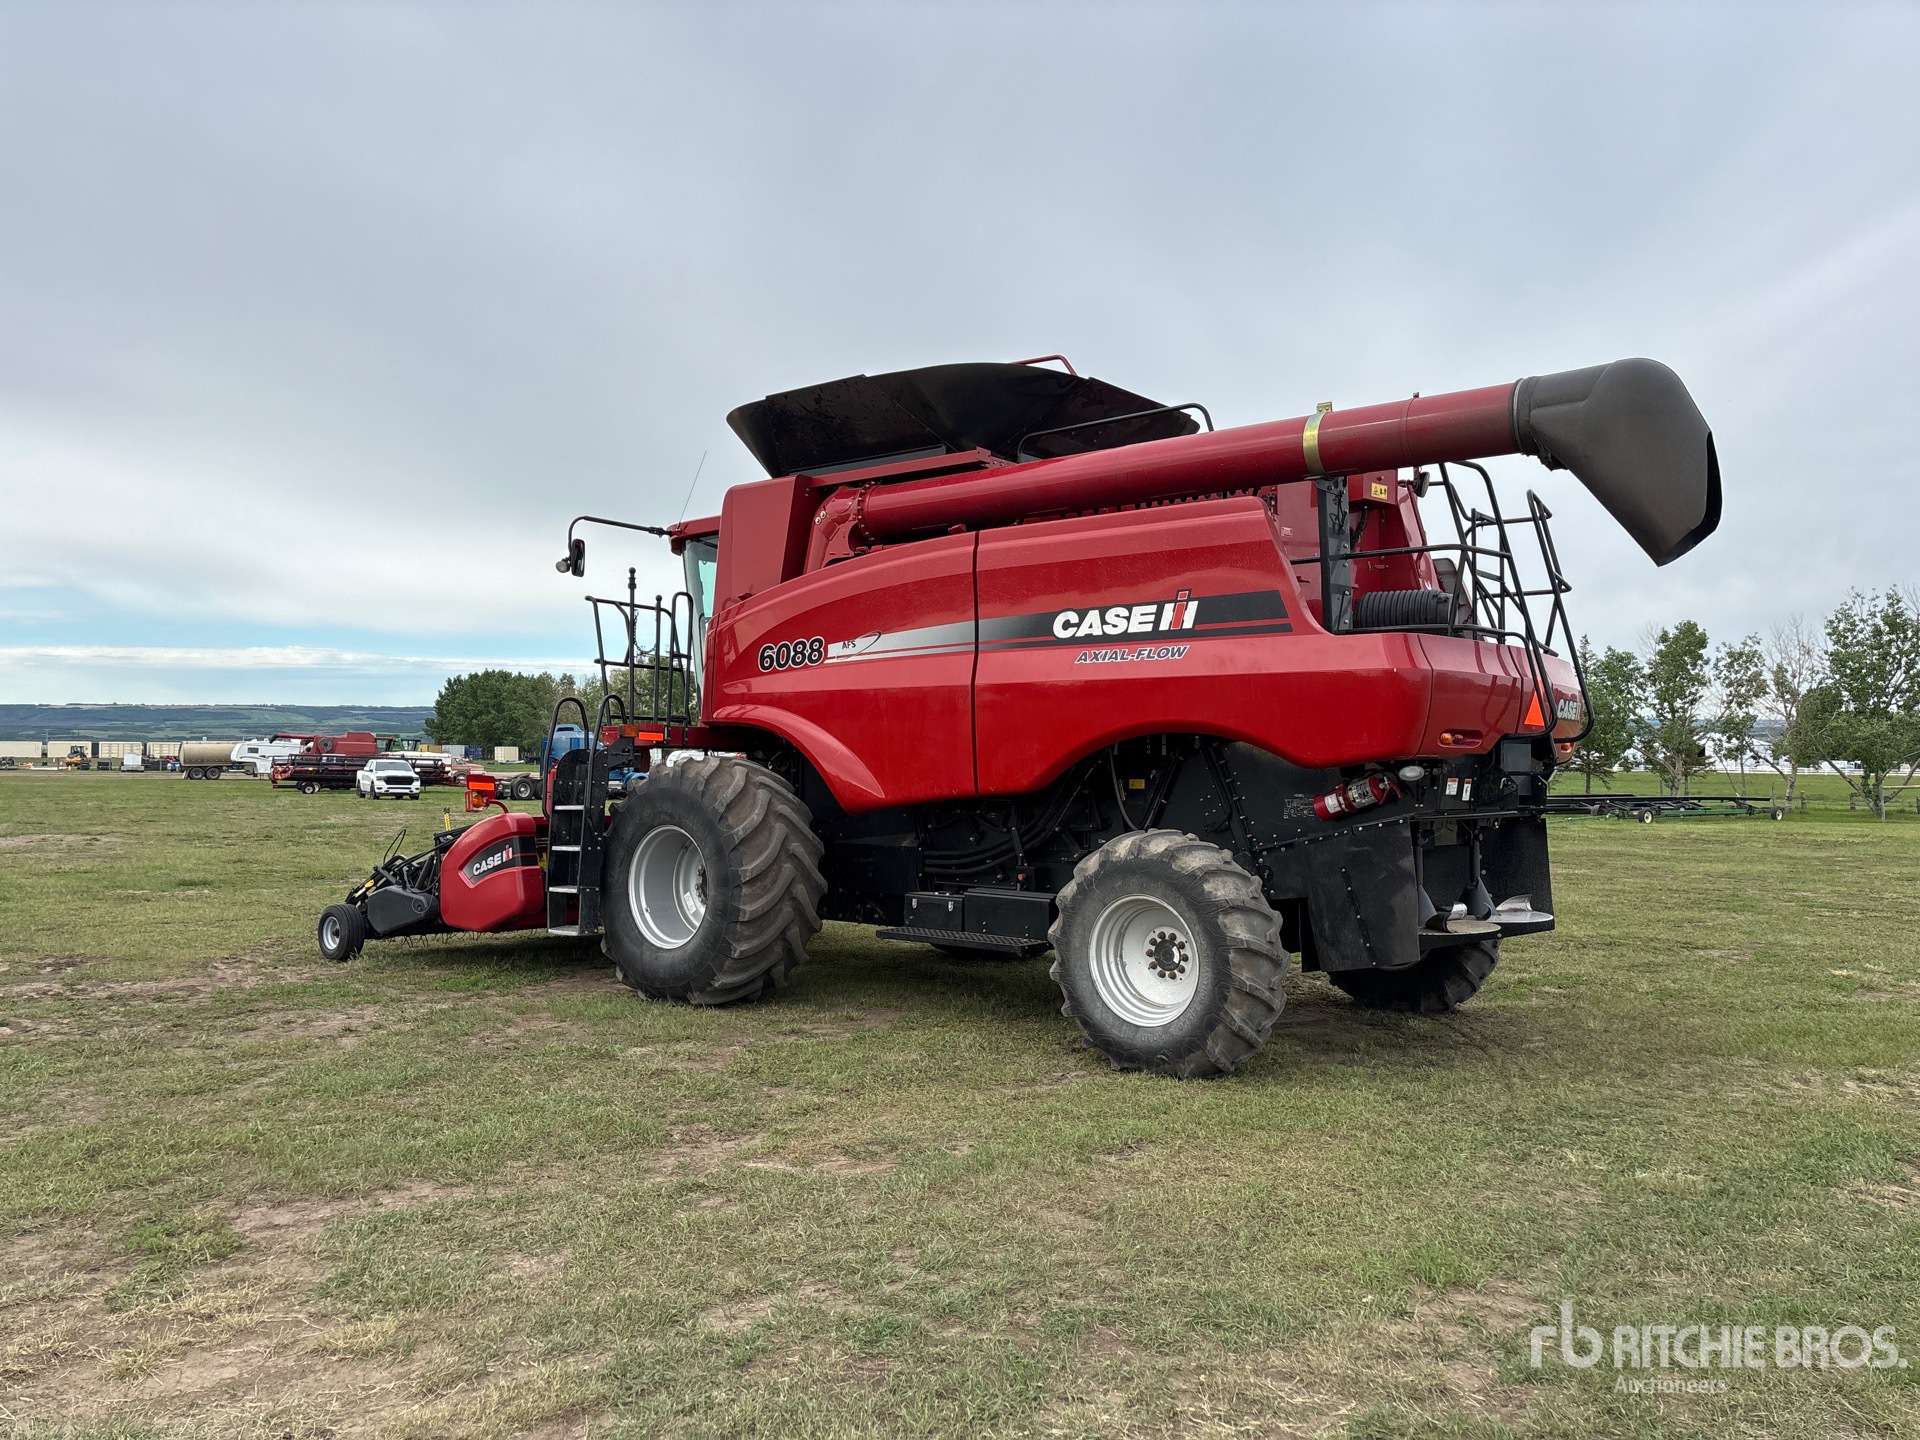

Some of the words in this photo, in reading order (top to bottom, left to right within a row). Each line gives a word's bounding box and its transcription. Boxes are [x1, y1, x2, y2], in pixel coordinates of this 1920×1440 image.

[1053, 604, 1157, 639] CASE
[758, 636, 825, 672] 6088
[842, 639, 856, 650] AFS
[1074, 645, 1190, 663] AXIAL-FLOW
[1557, 699, 1576, 720] CASE
[473, 853, 501, 875] CASE
